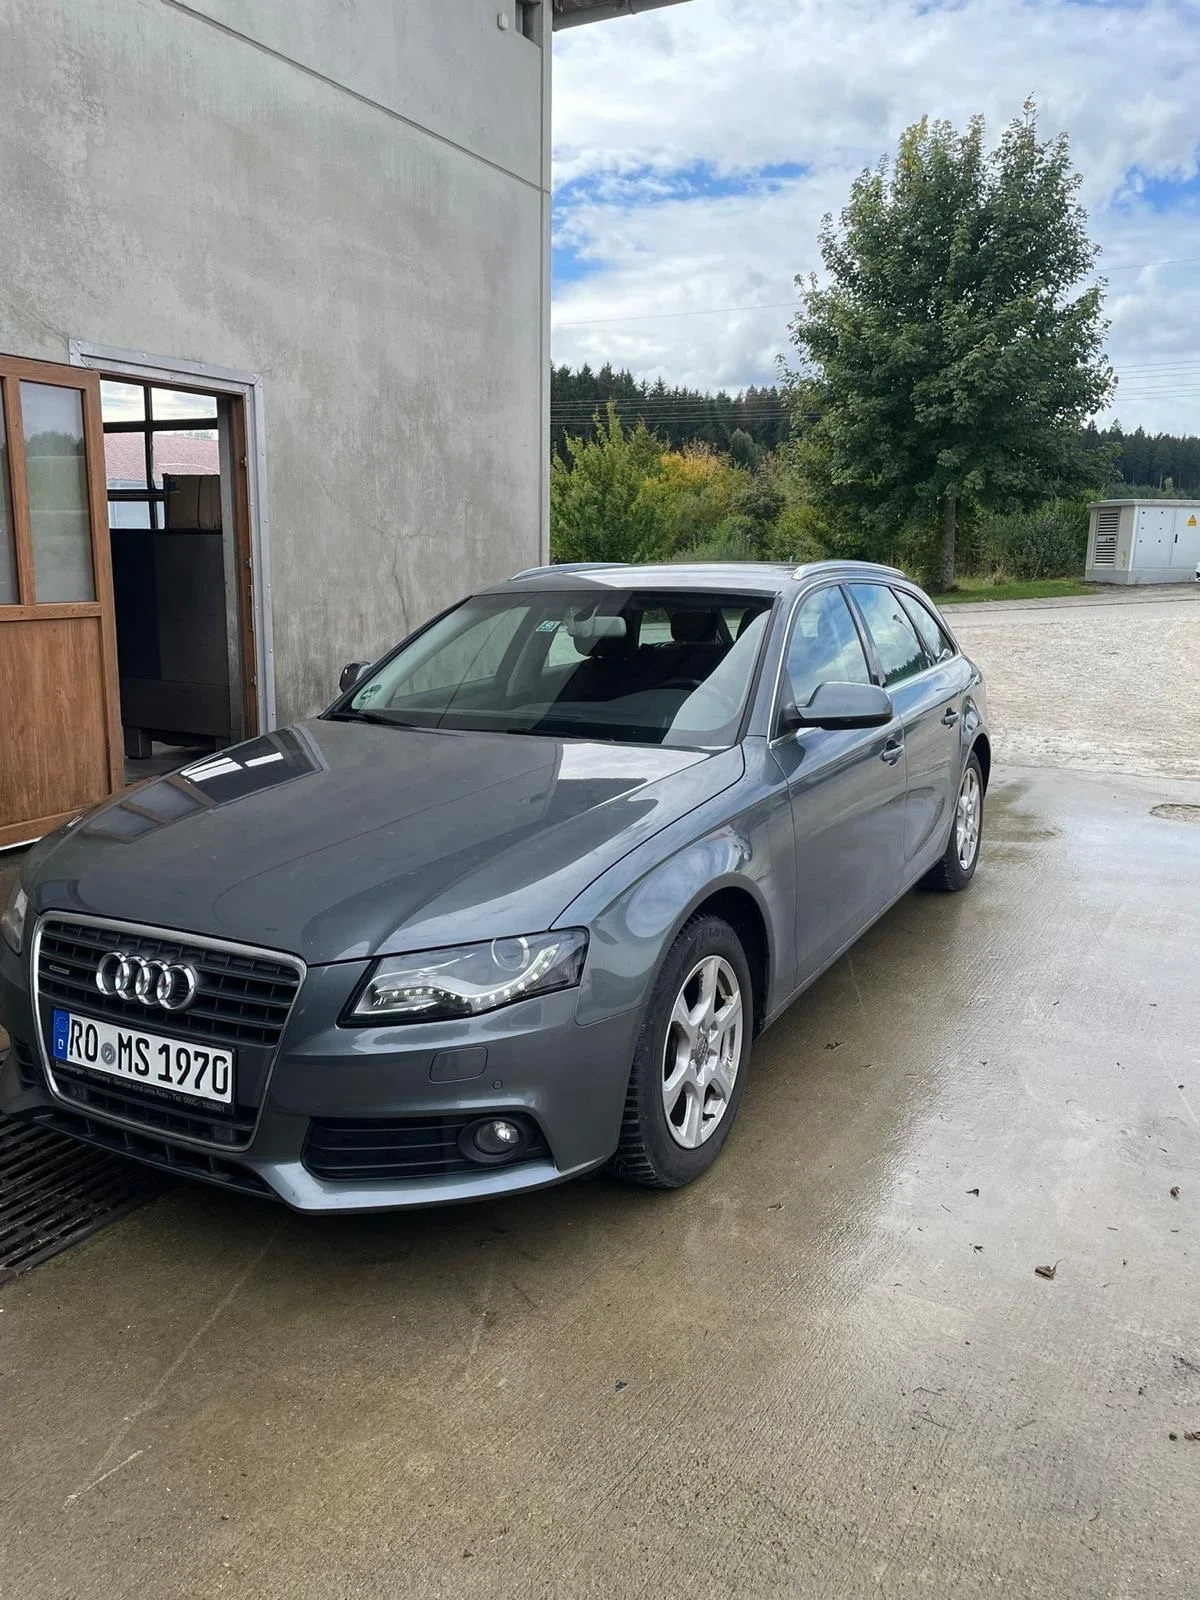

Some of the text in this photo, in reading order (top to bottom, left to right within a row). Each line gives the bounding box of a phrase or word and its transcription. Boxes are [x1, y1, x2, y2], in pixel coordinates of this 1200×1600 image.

[69, 1019, 228, 1095] RO MS 1970
